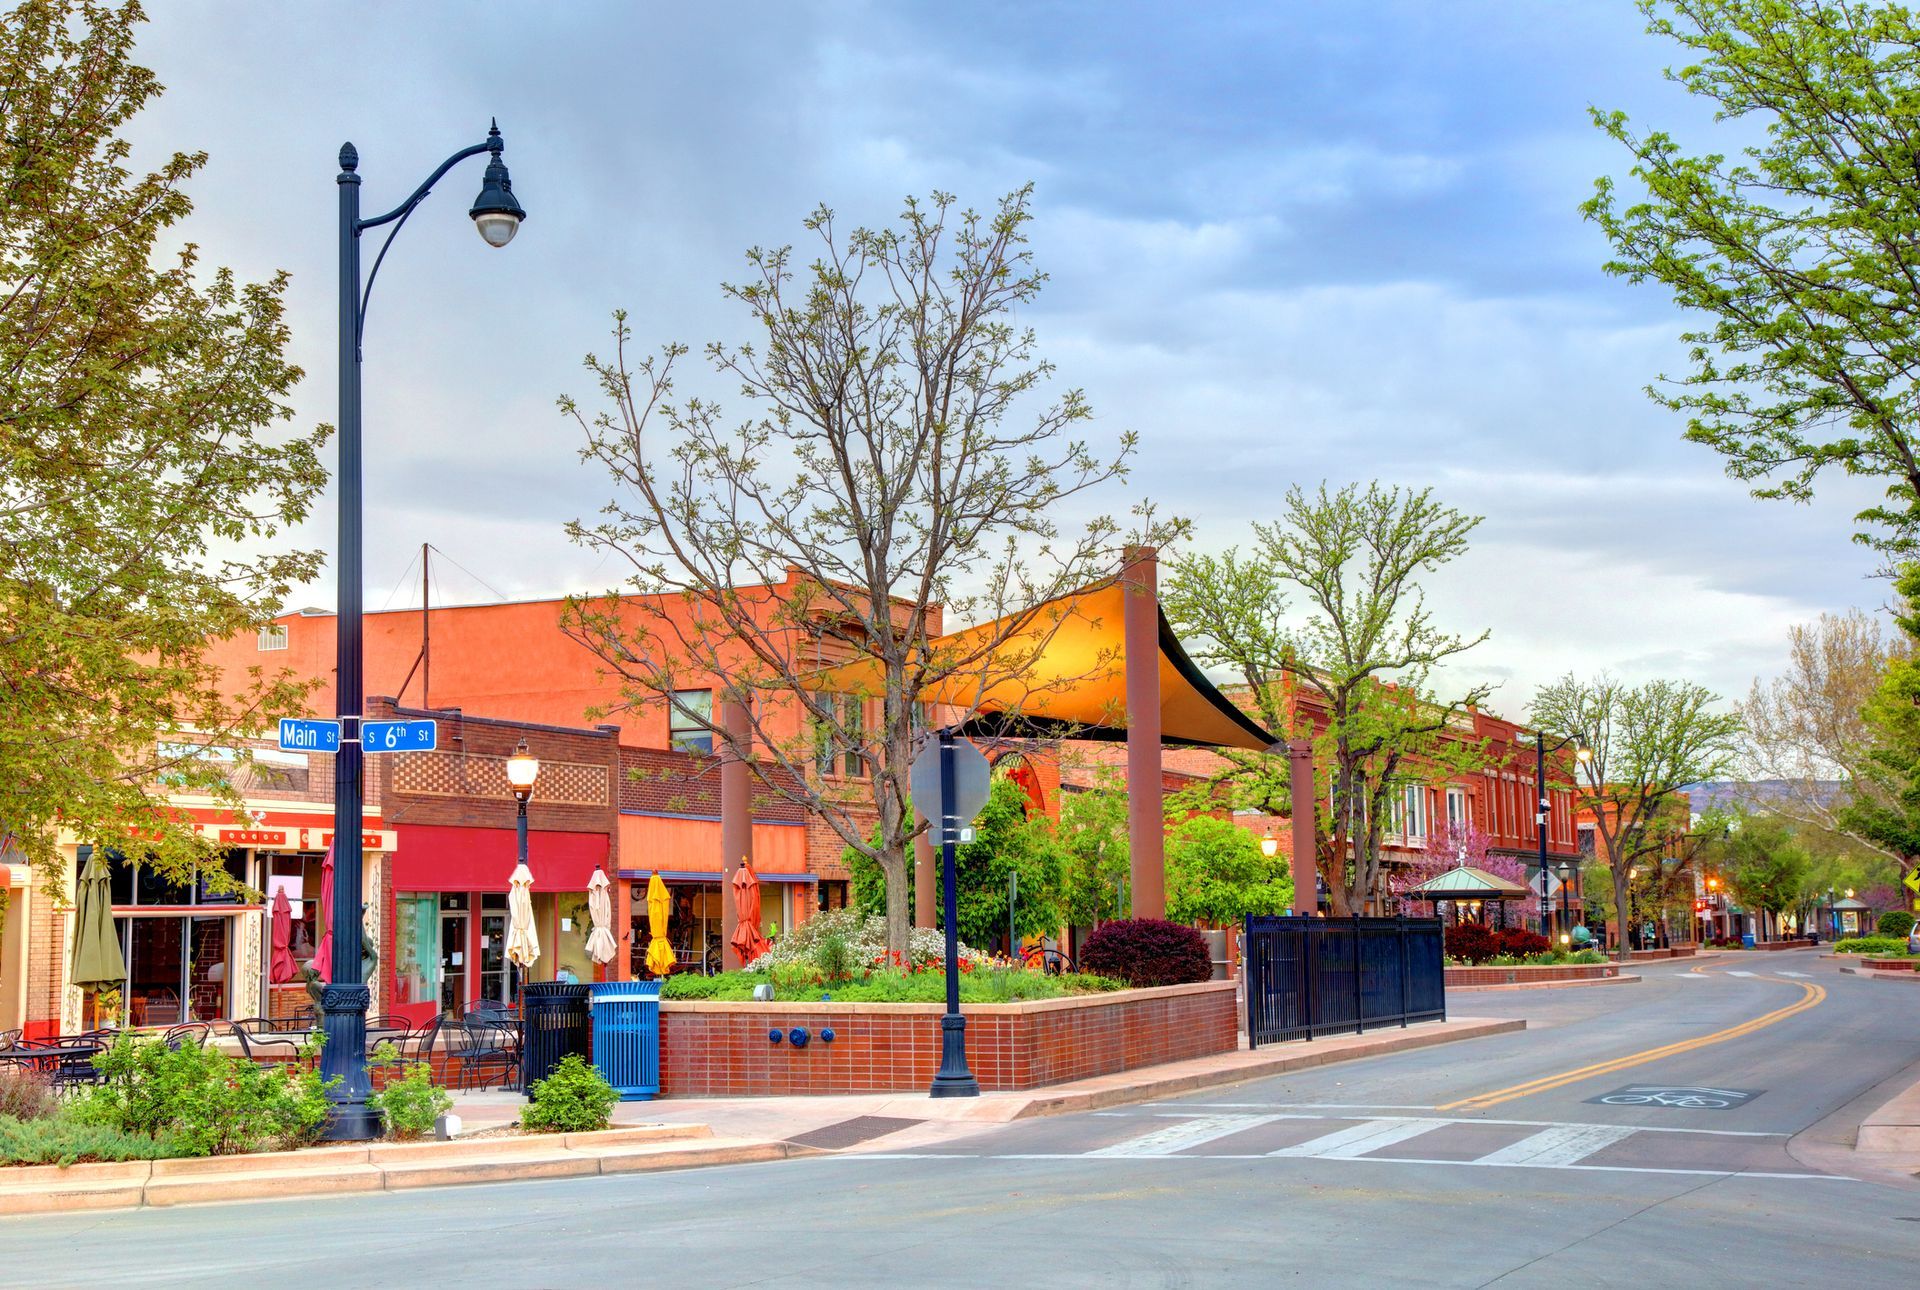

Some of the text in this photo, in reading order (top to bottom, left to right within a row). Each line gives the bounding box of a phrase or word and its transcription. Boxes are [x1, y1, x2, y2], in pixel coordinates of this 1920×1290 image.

[283, 723, 335, 747] Main St
[369, 726, 429, 748] S 6th St
